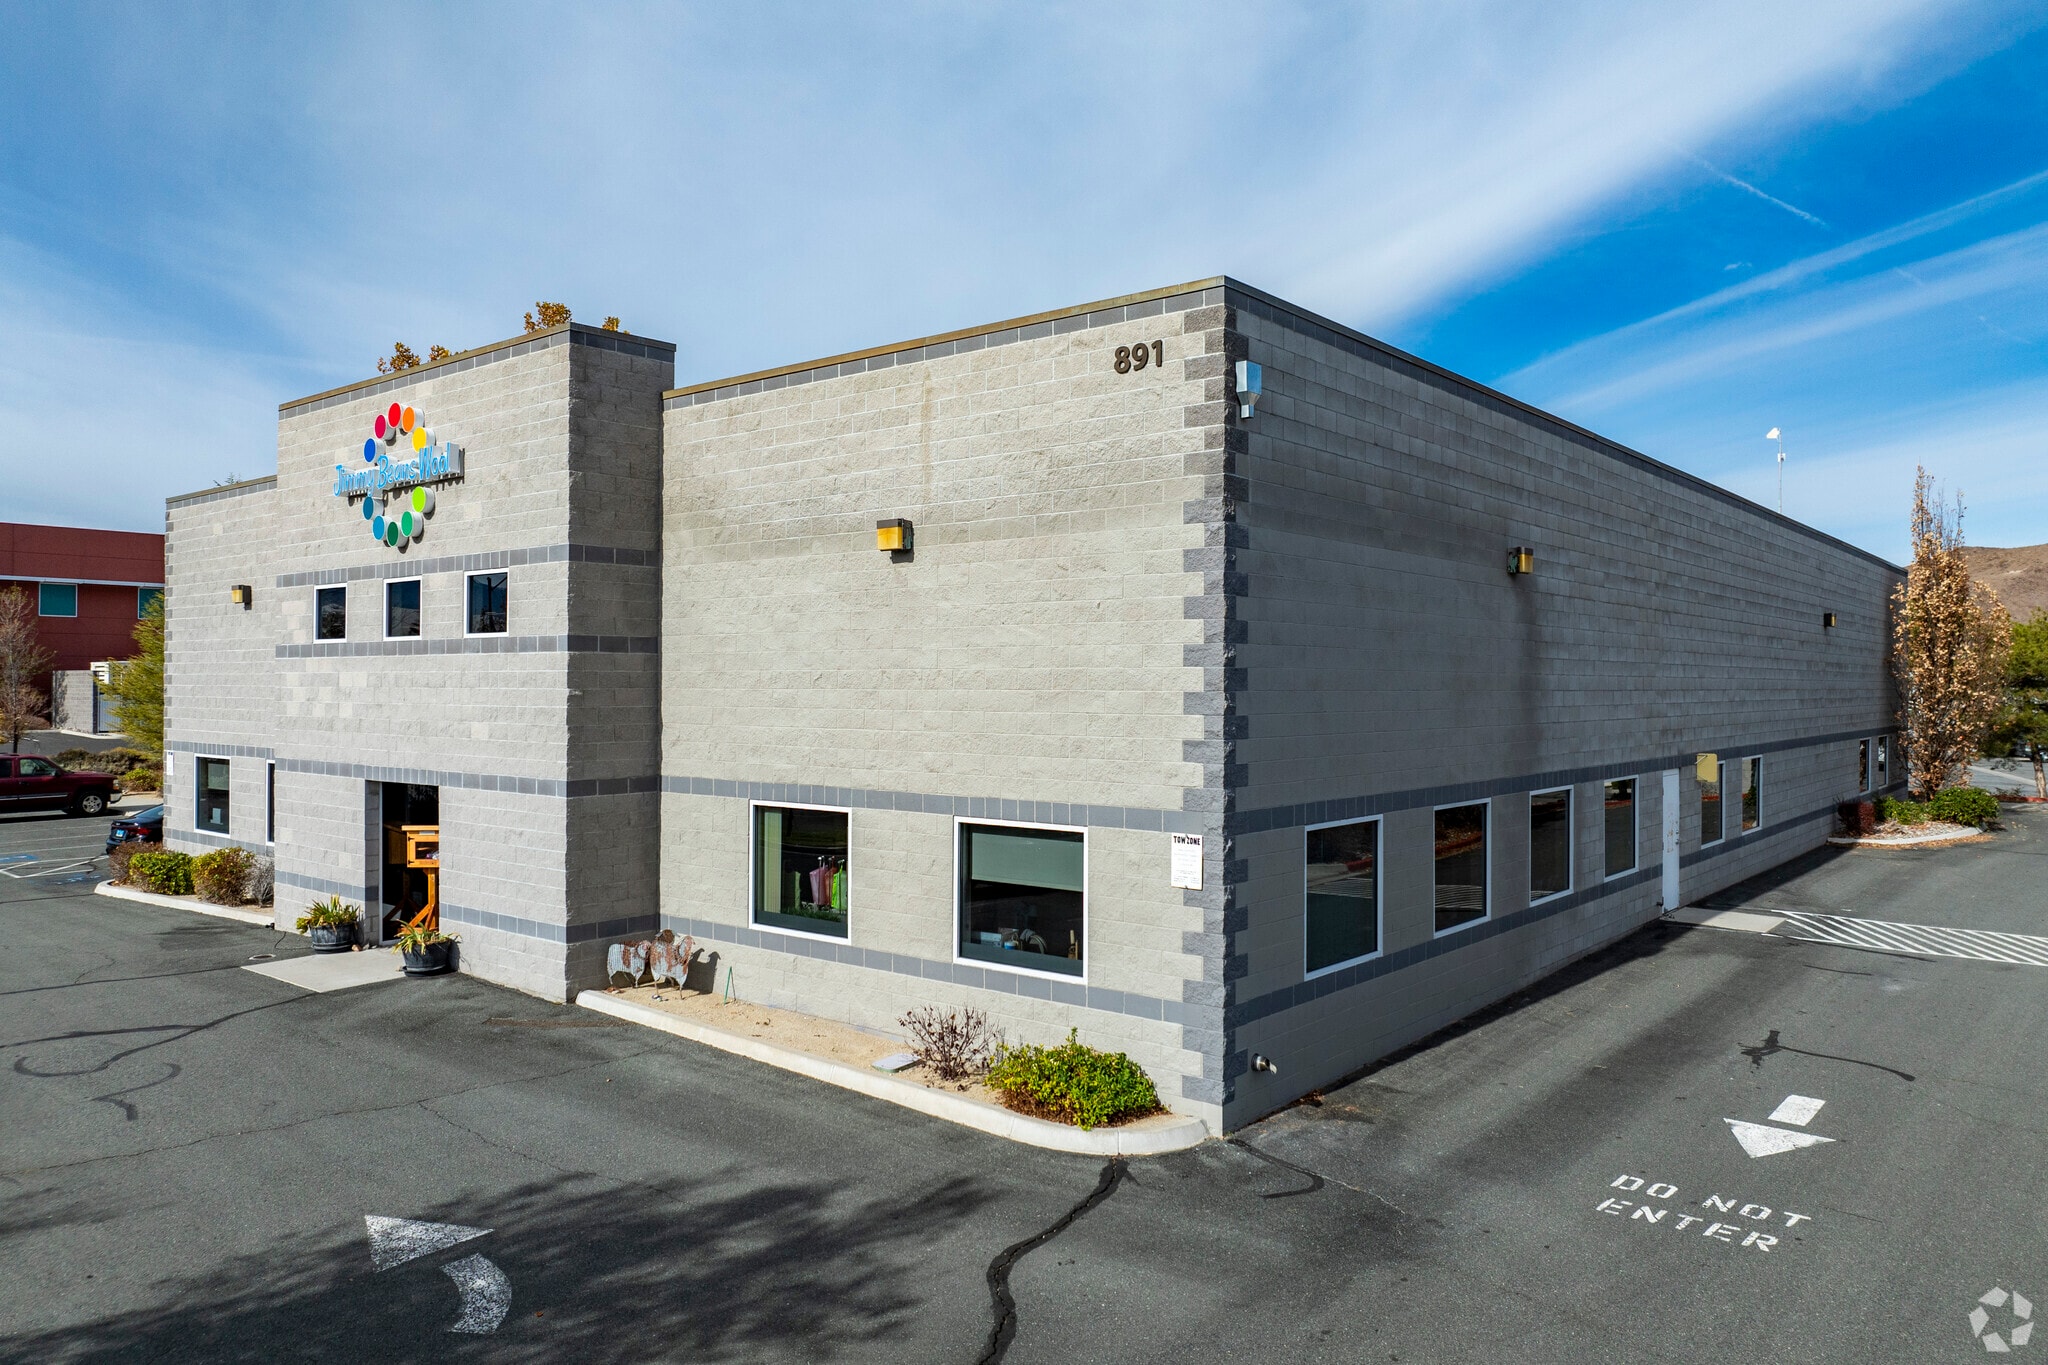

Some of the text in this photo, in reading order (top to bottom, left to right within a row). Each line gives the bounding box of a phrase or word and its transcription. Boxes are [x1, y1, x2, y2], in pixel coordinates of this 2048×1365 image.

[1114, 339, 1163, 374] 891
[333, 442, 451, 497] Jimmy Beans Wool
[1173, 836, 1200, 845] TOW ZONE
[1596, 1198, 1779, 1252] ENTER
[1610, 1174, 1811, 1227] DO NOT
